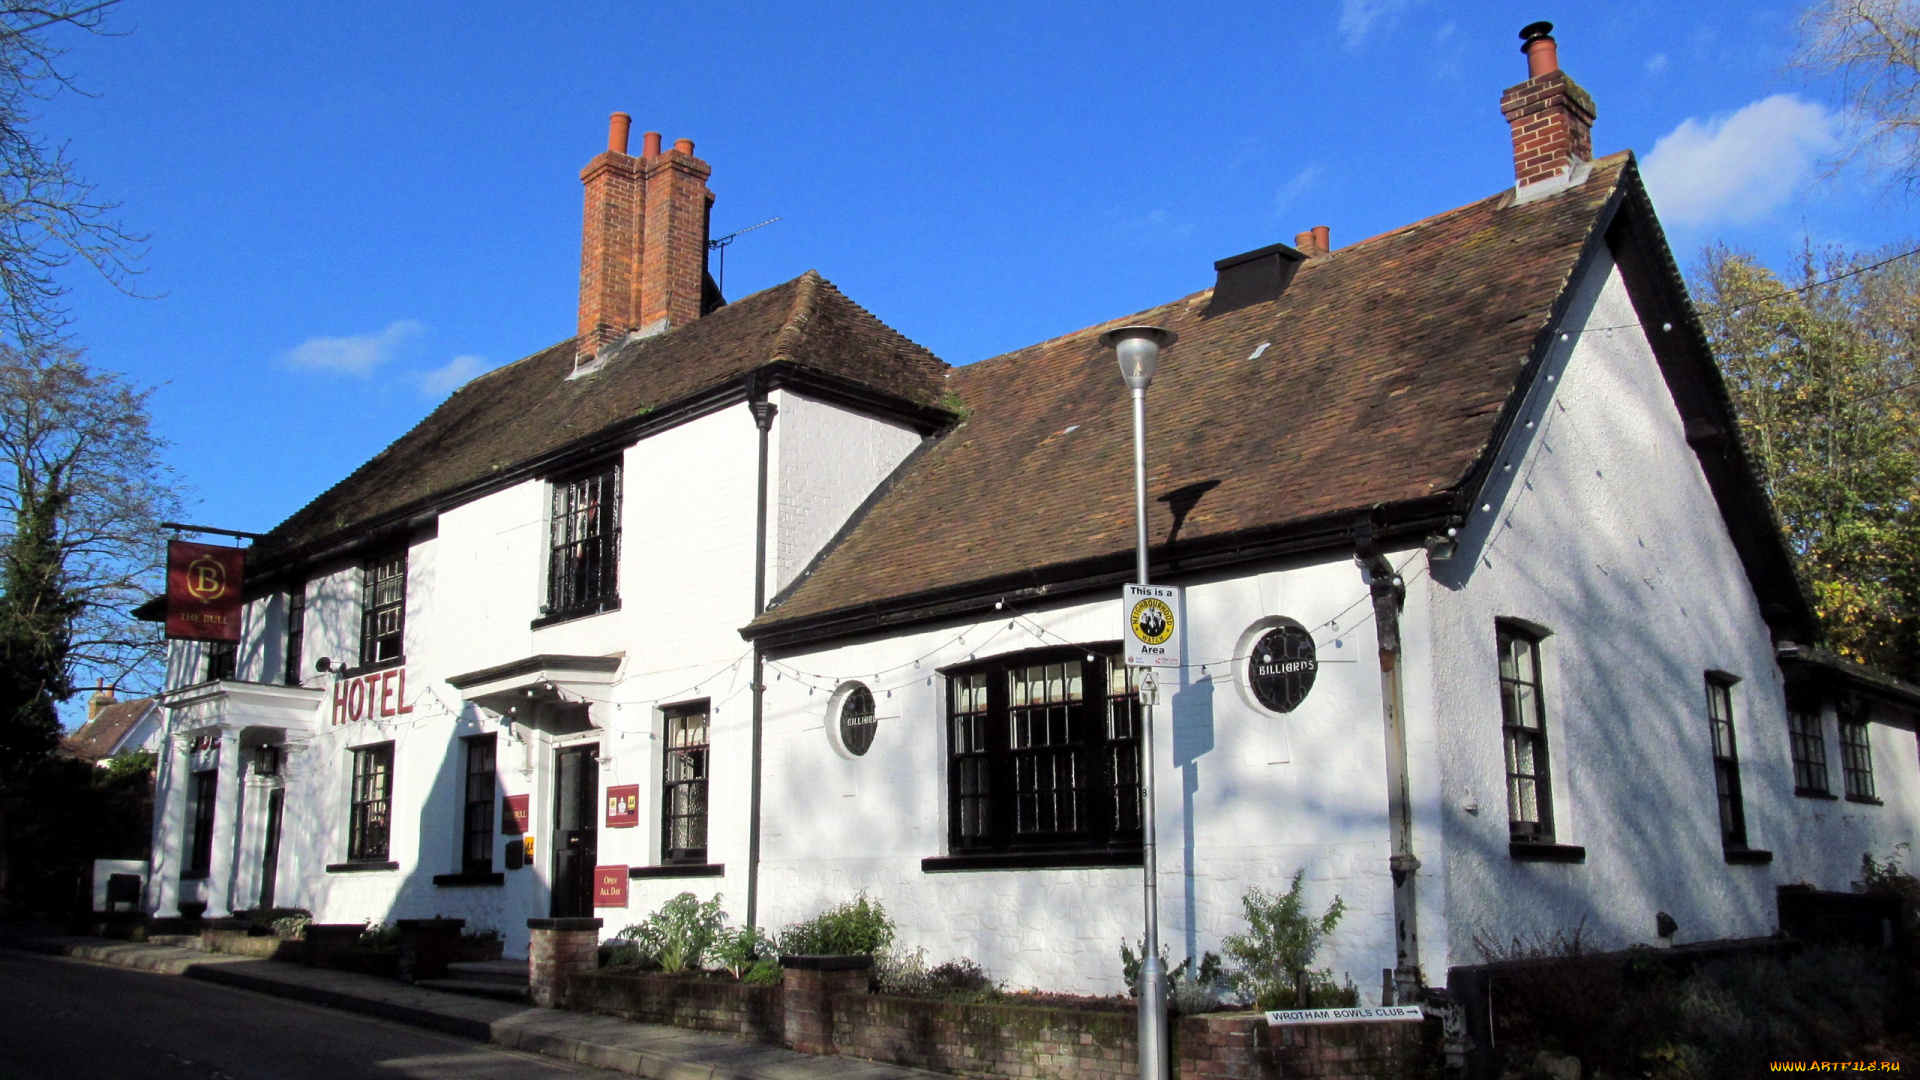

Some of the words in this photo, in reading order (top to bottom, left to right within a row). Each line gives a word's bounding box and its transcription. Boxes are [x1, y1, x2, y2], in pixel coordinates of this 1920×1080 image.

[196, 566, 219, 592] B
[1130, 587, 1152, 596] This
[1154, 588, 1163, 596] is
[181, 613, 200, 622] THE
[203, 614, 229, 625] BULL
[1132, 600, 1173, 626] NEIGHBOURHOOD
[1142, 634, 1164, 643] WATCH
[1141, 645, 1165, 654] Area
[1259, 660, 1315, 676] BILLIARDS
[332, 668, 414, 726] HOTEL
[1272, 1011, 1330, 1021] WROTHAM
[1333, 1009, 1373, 1018] BOWLS
[1375, 1008, 1405, 1016] CLUB
